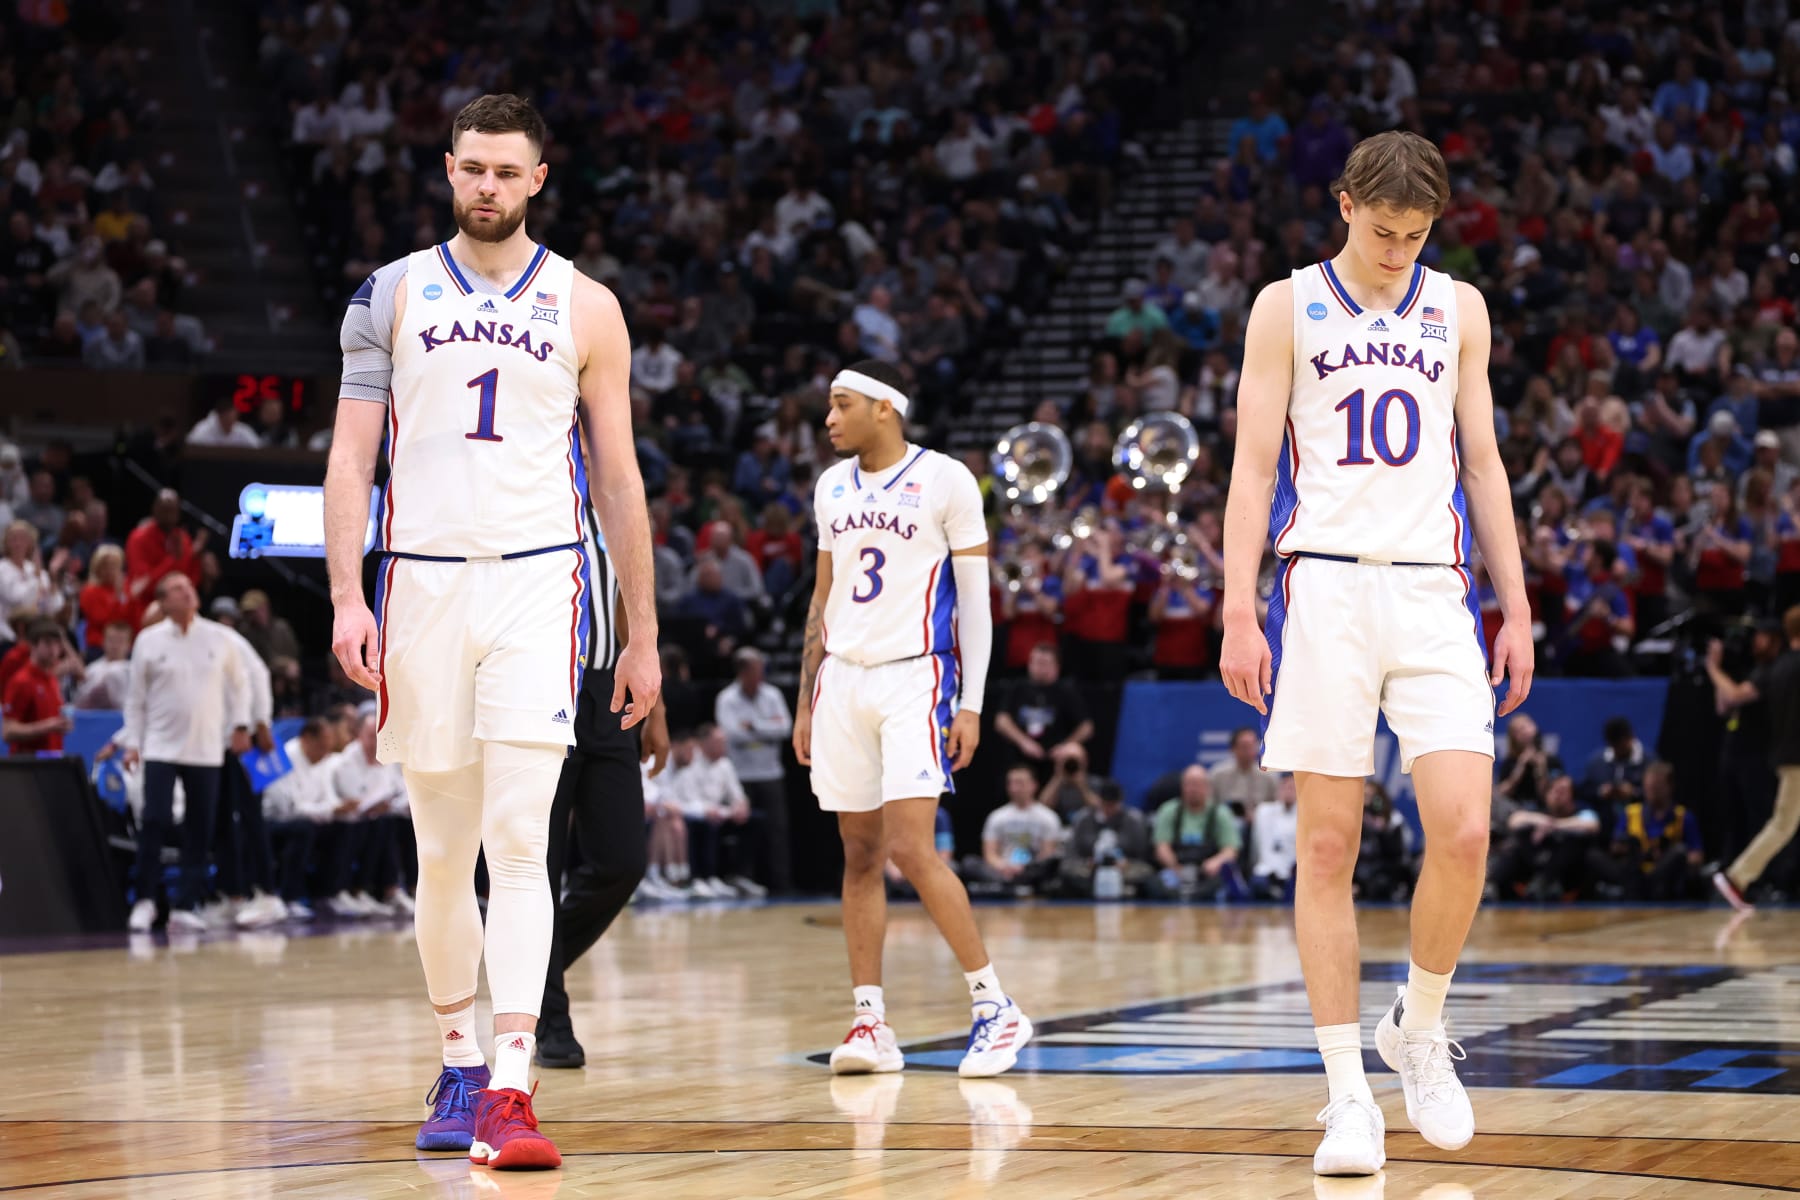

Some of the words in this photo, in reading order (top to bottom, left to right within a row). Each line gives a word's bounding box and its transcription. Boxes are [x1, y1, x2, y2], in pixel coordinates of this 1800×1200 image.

[418, 320, 553, 362] KANSAS
[1310, 342, 1445, 383] KANSAS
[465, 367, 504, 442] 1
[1335, 388, 1421, 467] 10
[830, 511, 918, 541] KANSAS
[852, 547, 886, 603] 3
